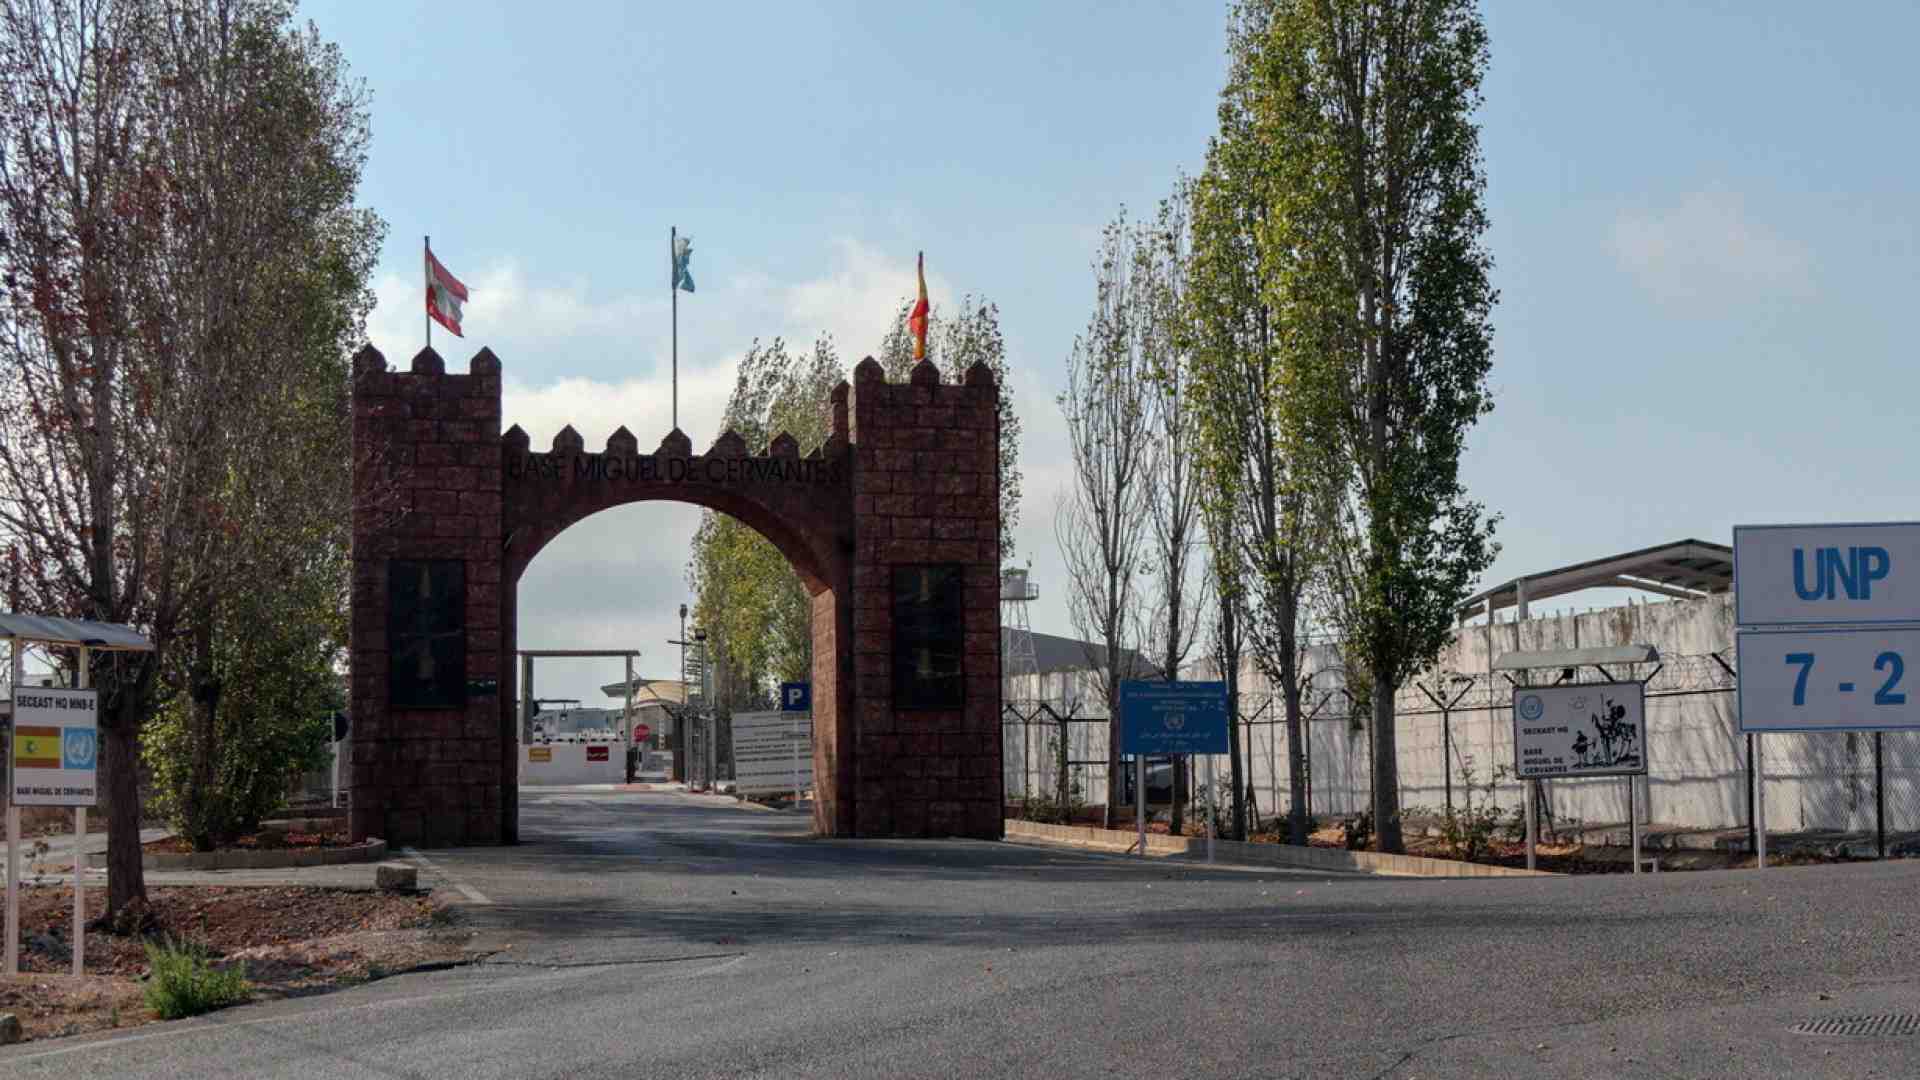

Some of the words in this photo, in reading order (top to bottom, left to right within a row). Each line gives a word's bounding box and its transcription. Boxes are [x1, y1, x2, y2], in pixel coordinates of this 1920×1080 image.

[508, 456, 566, 481] BASE
[574, 456, 664, 481] MIGUEL
[669, 456, 699, 481] DE
[704, 455, 842, 482] CERVANTES
[1792, 546, 1890, 601] UNP
[17, 696, 54, 709] SECEAST
[788, 688, 803, 706] P
